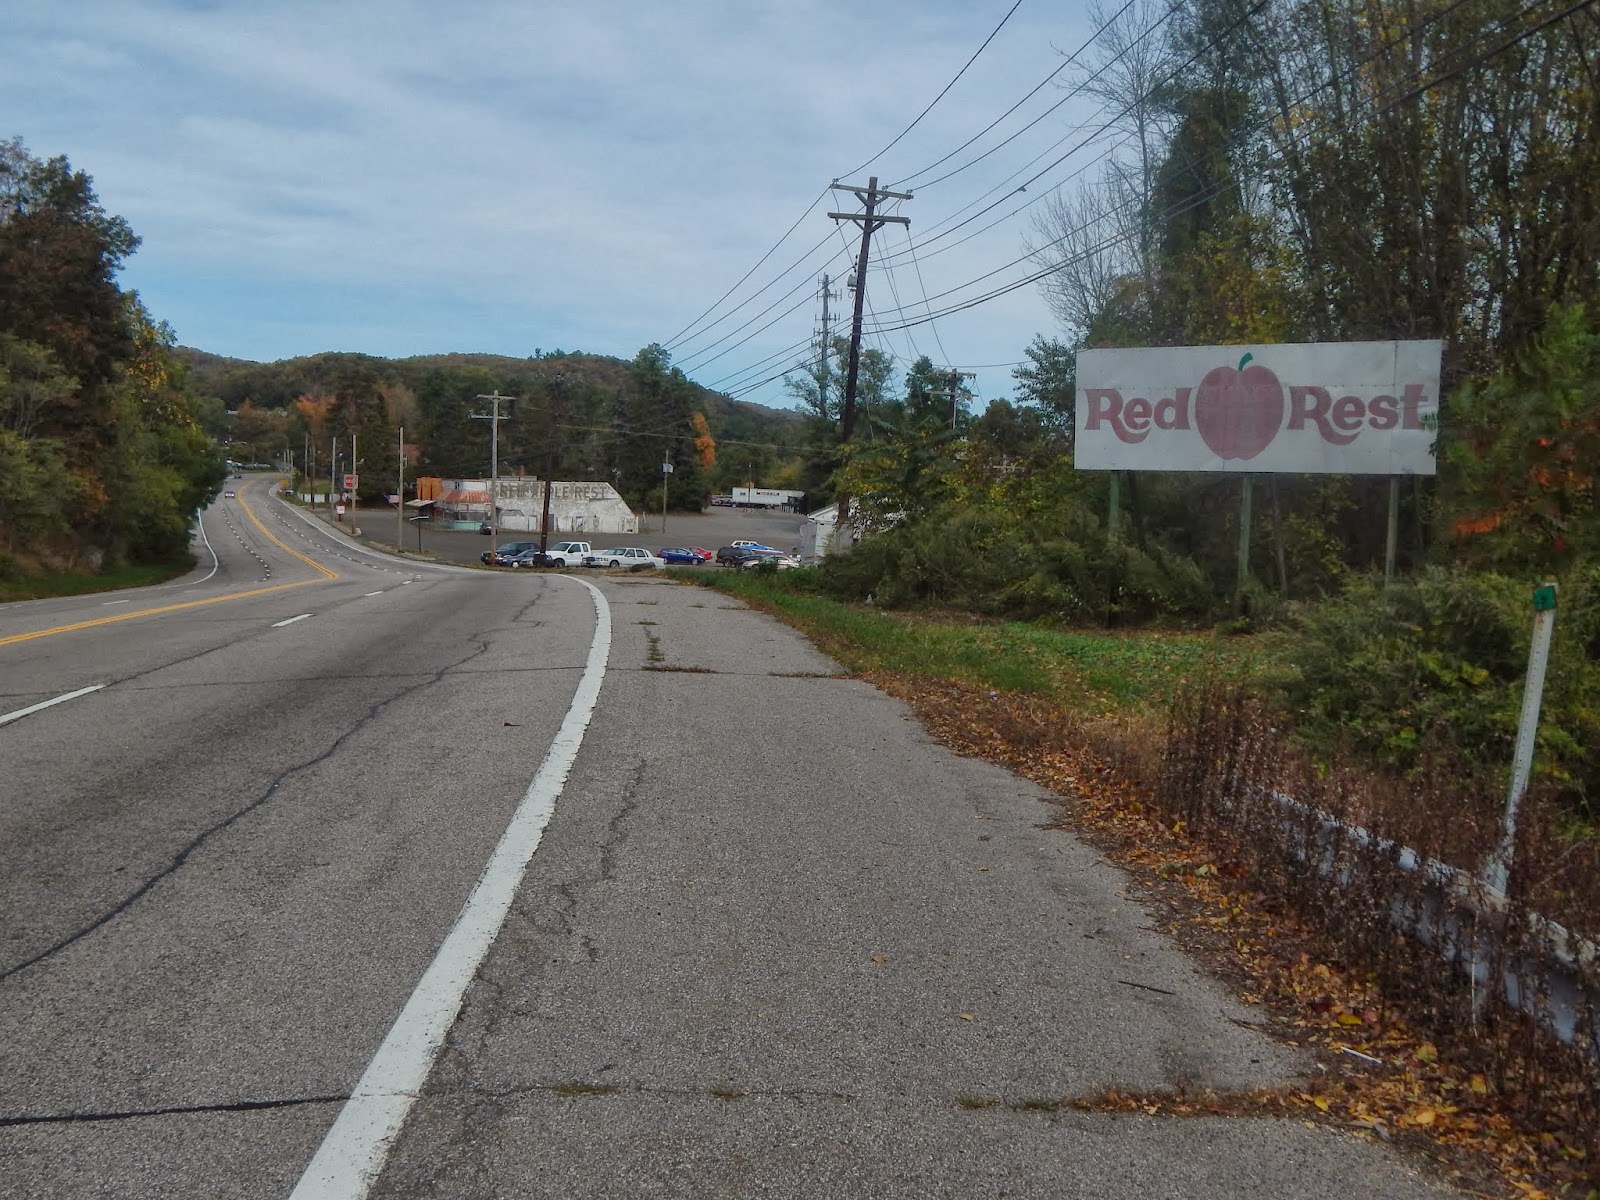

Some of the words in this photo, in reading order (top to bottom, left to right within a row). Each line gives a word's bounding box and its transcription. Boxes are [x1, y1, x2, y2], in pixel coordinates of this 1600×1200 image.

[1084, 387, 1192, 444] Red
[1288, 383, 1429, 446] Rest
[574, 485, 607, 499] REST
